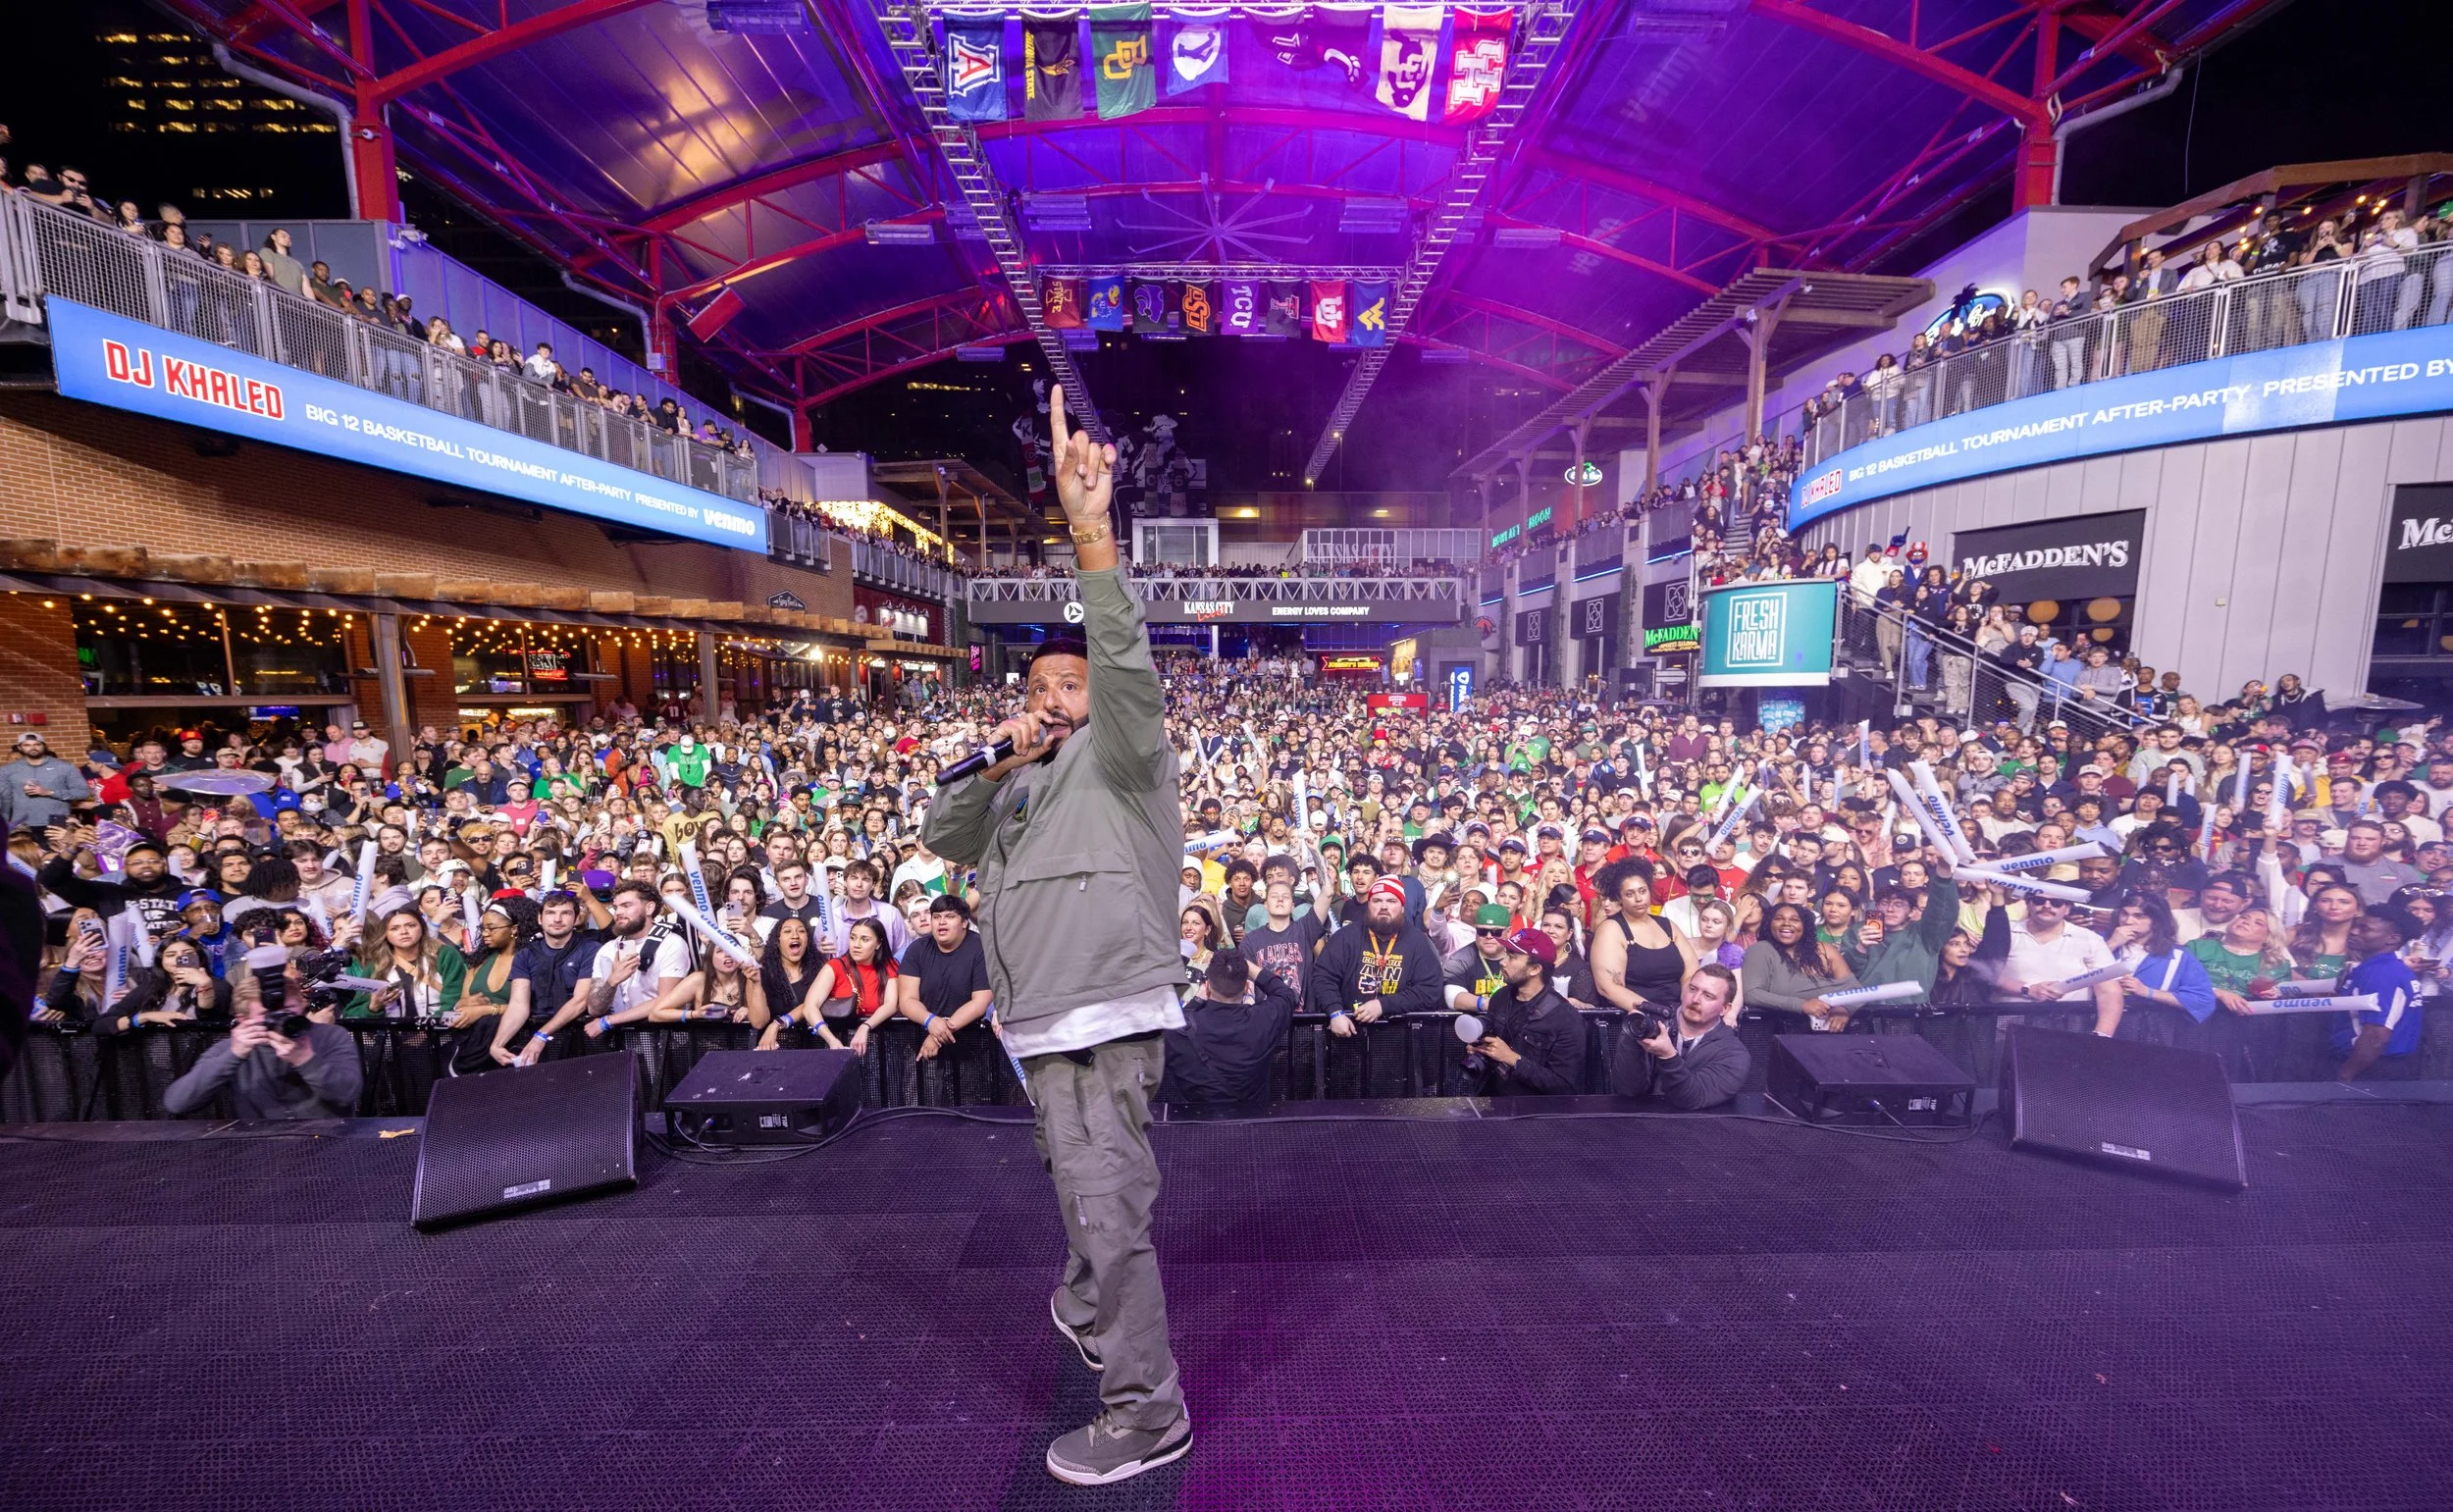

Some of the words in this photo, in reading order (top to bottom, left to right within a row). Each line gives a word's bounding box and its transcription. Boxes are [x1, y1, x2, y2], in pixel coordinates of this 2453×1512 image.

[1024, 30, 1035, 69] ARIZONA
[1026, 70, 1035, 101] STATE
[2253, 261, 2285, 275] TUPA
[1230, 286, 1253, 329] TCU
[103, 339, 153, 389] DJ
[162, 354, 286, 422] KHALED
[1849, 469, 1865, 482] BIG
[1866, 463, 1877, 477] 12
[1878, 442, 1958, 471] BASKETBALL
[1962, 411, 2089, 451] TOURNAMENT
[2092, 384, 2253, 425] AFTER-PARTY
[2263, 361, 2420, 398] PRESENTED
[2427, 357, 2453, 378] BY
[306, 403, 339, 426] BIG
[341, 413, 361, 433] 12
[363, 419, 465, 459] BASKETBALL
[466, 446, 558, 482] TOURNAMENT
[560, 472, 632, 502] AFTER-PARTY
[635, 493, 687, 516] PRESENTED
[687, 506, 699, 519] BY
[704, 508, 756, 537] venmo
[1809, 468, 1843, 504] KHALED
[2398, 517, 2453, 549] Mc
[1963, 540, 2129, 580] McFADDEN'S
[1183, 601, 1215, 614] KANSAS
[1216, 601, 1234, 614] CITY
[1272, 606, 1303, 616] ENERGY
[1304, 606, 1329, 616] LOVES
[1330, 606, 1370, 616] COMPANY
[1734, 599, 1780, 632] FRESH
[1644, 625, 1702, 648] McFADDEN'
[1732, 629, 1778, 662] KARMA
[669, 704, 679, 718] 11
[2276, 773, 2289, 804] venmo
[1293, 792, 1303, 829] venmo
[1719, 807, 1745, 836] venmo
[1928, 795, 1955, 837] venmo
[674, 819, 704, 843] LOV
[2001, 856, 2055, 872] venmo
[125, 898, 180, 912] K-STAT
[349, 873, 363, 915] venmo
[690, 871, 708, 912] venmo
[818, 894, 829, 932] venmo
[117, 946, 128, 987] venmo
[2272, 998, 2332, 1009] venmo
